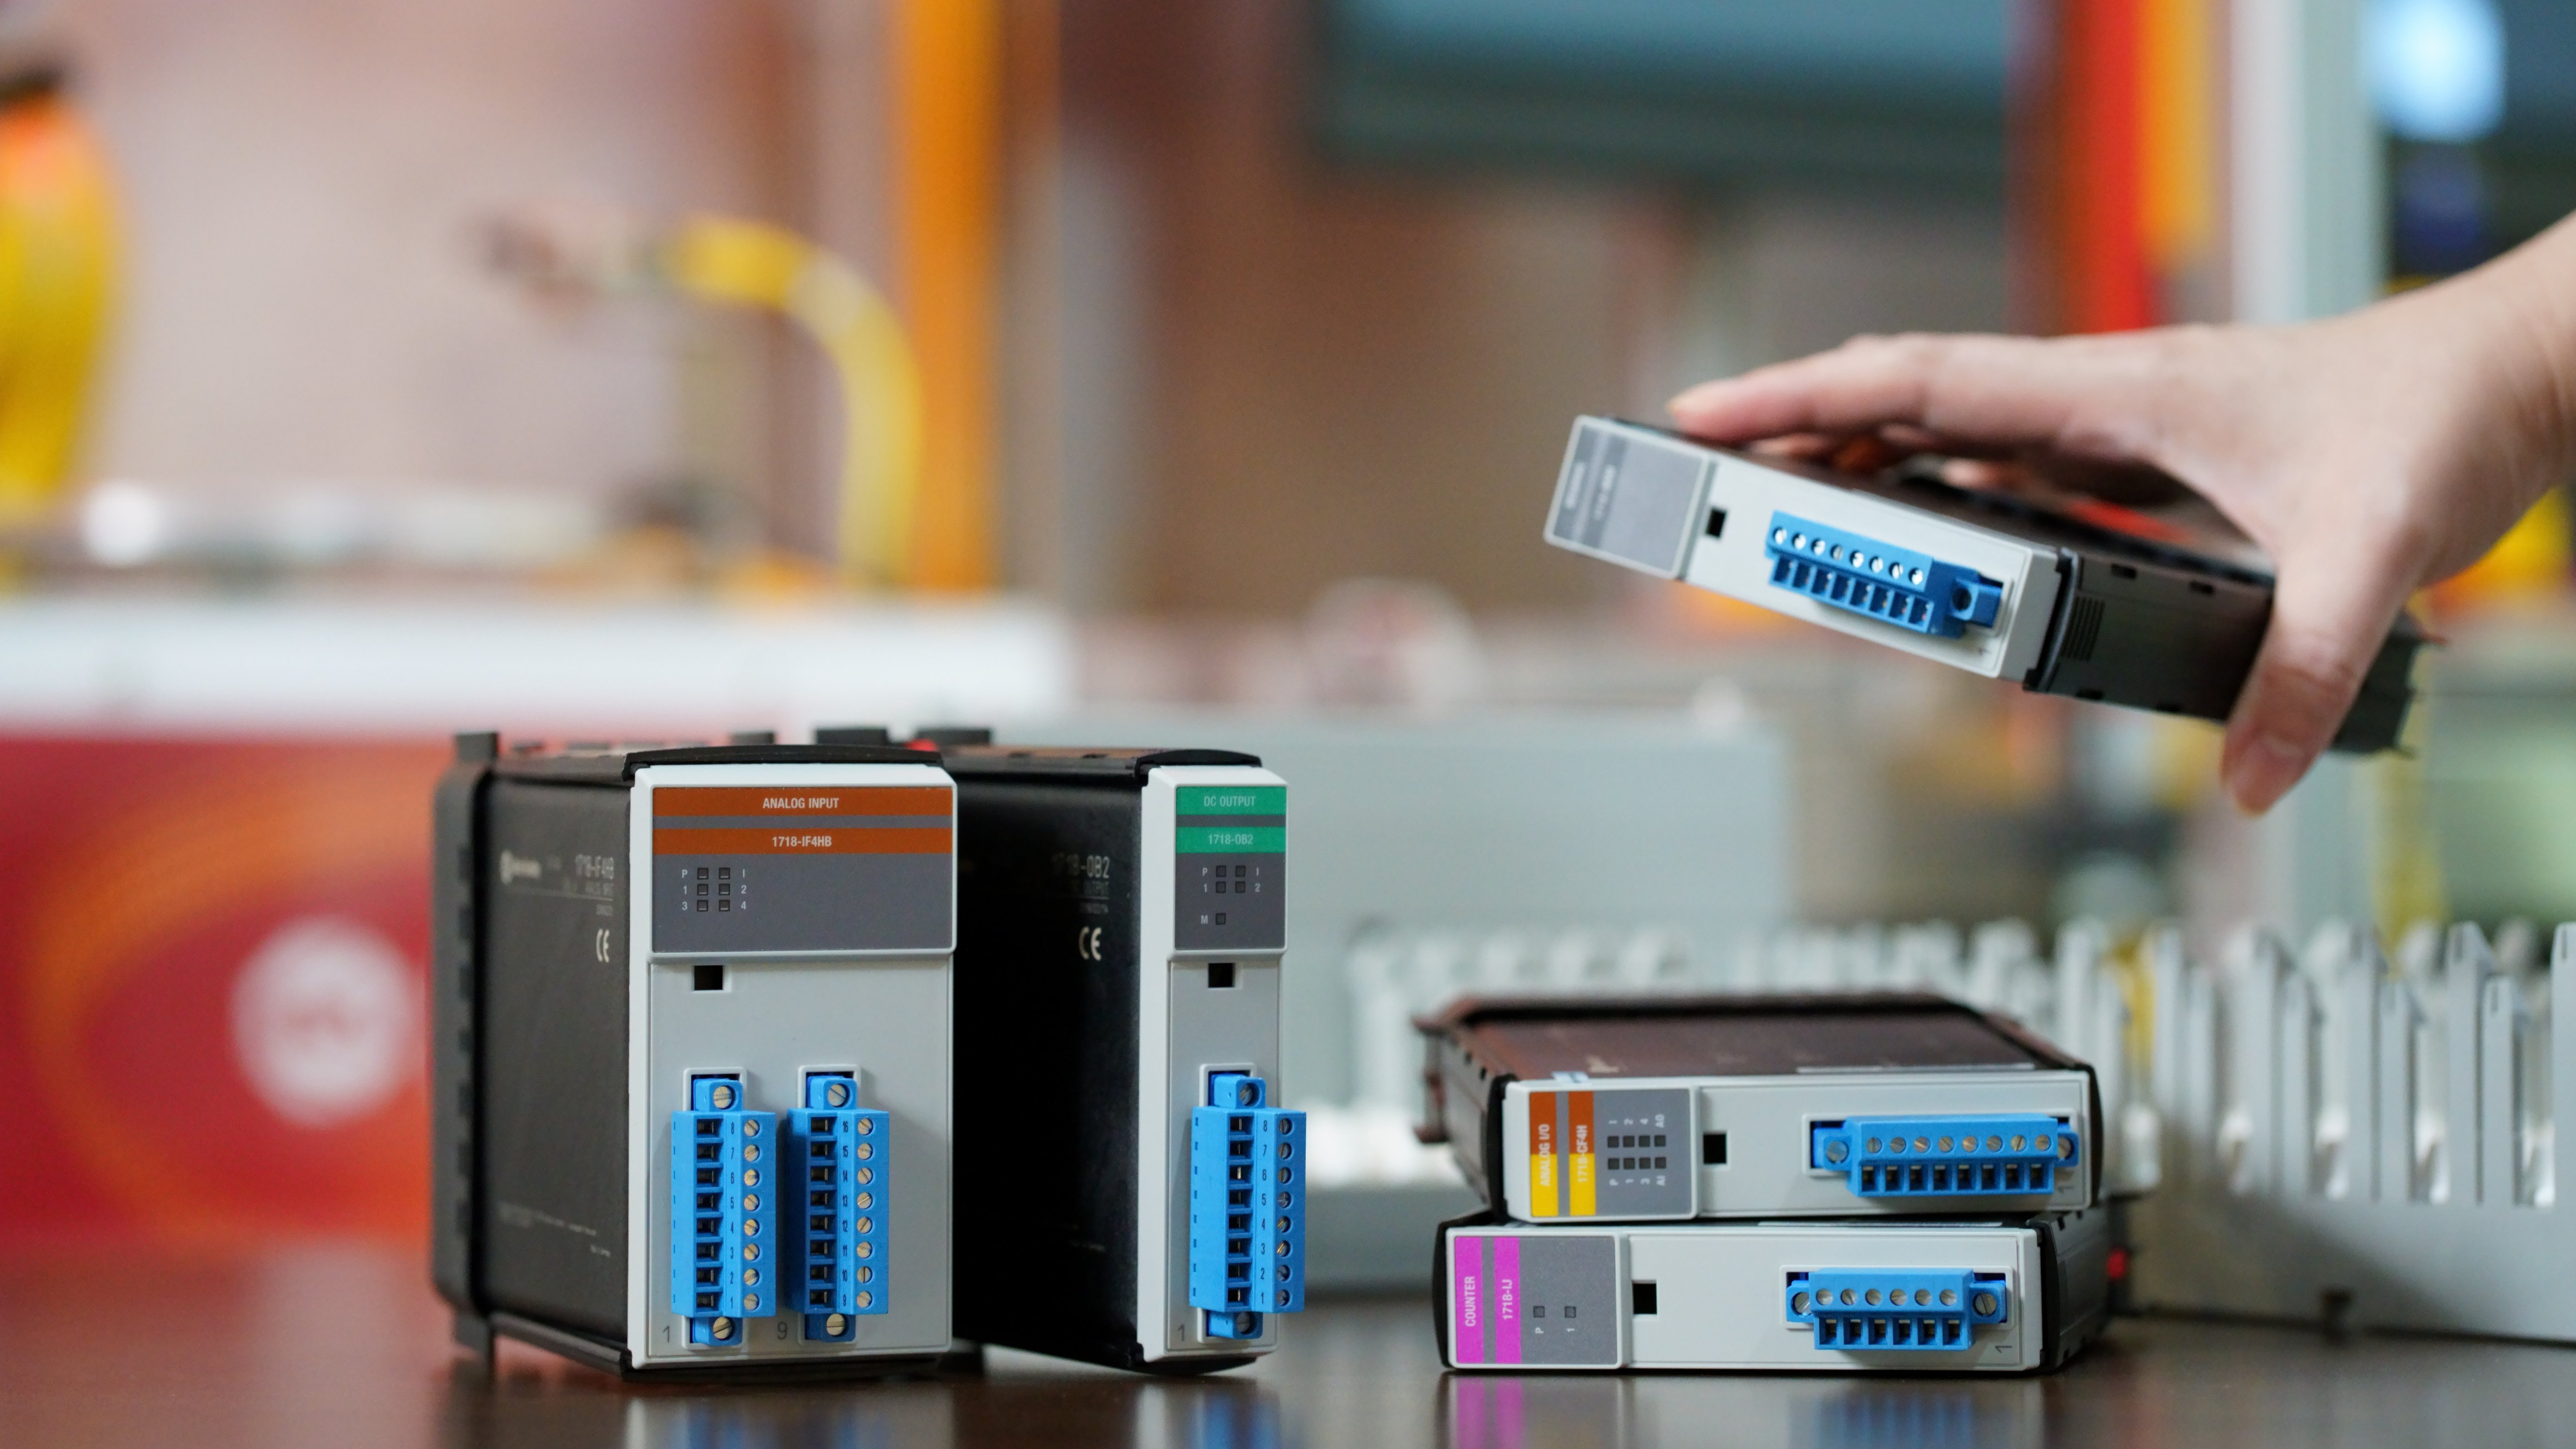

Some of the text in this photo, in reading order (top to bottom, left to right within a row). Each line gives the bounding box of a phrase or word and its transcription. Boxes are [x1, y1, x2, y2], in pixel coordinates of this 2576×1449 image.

[763, 797, 839, 809] ANALOG INPUT
[1203, 795, 1256, 807] DC OUTPUT
[772, 835, 832, 847] 1718-IF4HB
[682, 869, 688, 878] P
[1202, 867, 1208, 876] P
[683, 886, 687, 895] 1
[741, 884, 747, 894] 2
[1203, 883, 1208, 893] 1
[1255, 883, 1260, 893] 2
[682, 902, 688, 910] 3
[741, 901, 747, 910] 4
[731, 1122, 735, 1135] 8
[842, 1120, 849, 1133] 16
[1263, 1120, 1268, 1132] 8
[731, 1147, 735, 1159] 7
[842, 1145, 848, 1158] 15
[1262, 1144, 1267, 1157] 7
[1538, 1123, 1551, 1187] ANALOG I/O
[1576, 1124, 1588, 1182] 1718-CF4H
[731, 1172, 735, 1184] 6
[842, 1170, 848, 1182] 14
[1262, 1169, 1266, 1181] 6
[1609, 1178, 1619, 1186] P
[730, 1196, 734, 1209] 5
[842, 1194, 848, 1207] 13
[1261, 1193, 1266, 1205] 5
[731, 1222, 734, 1234] 4
[842, 1220, 848, 1232] 12
[1261, 1218, 1265, 1231] 4
[730, 1246, 734, 1259] 3
[842, 1244, 847, 1257] 11
[1261, 1243, 1265, 1255] 3
[730, 1271, 734, 1284] 2
[842, 1269, 848, 1282] 10
[1260, 1267, 1265, 1280] 2
[730, 1297, 733, 1309] 1
[843, 1294, 846, 1307] 9
[1260, 1292, 1264, 1304] 1
[1464, 1276, 1477, 1327] COUNTER
[1501, 1279, 1513, 1320] 1718-IJ
[663, 1325, 670, 1343] 1
[777, 1322, 787, 1340] 9
[1178, 1324, 1185, 1341] 1
[1994, 1344, 2013, 1353] 1
